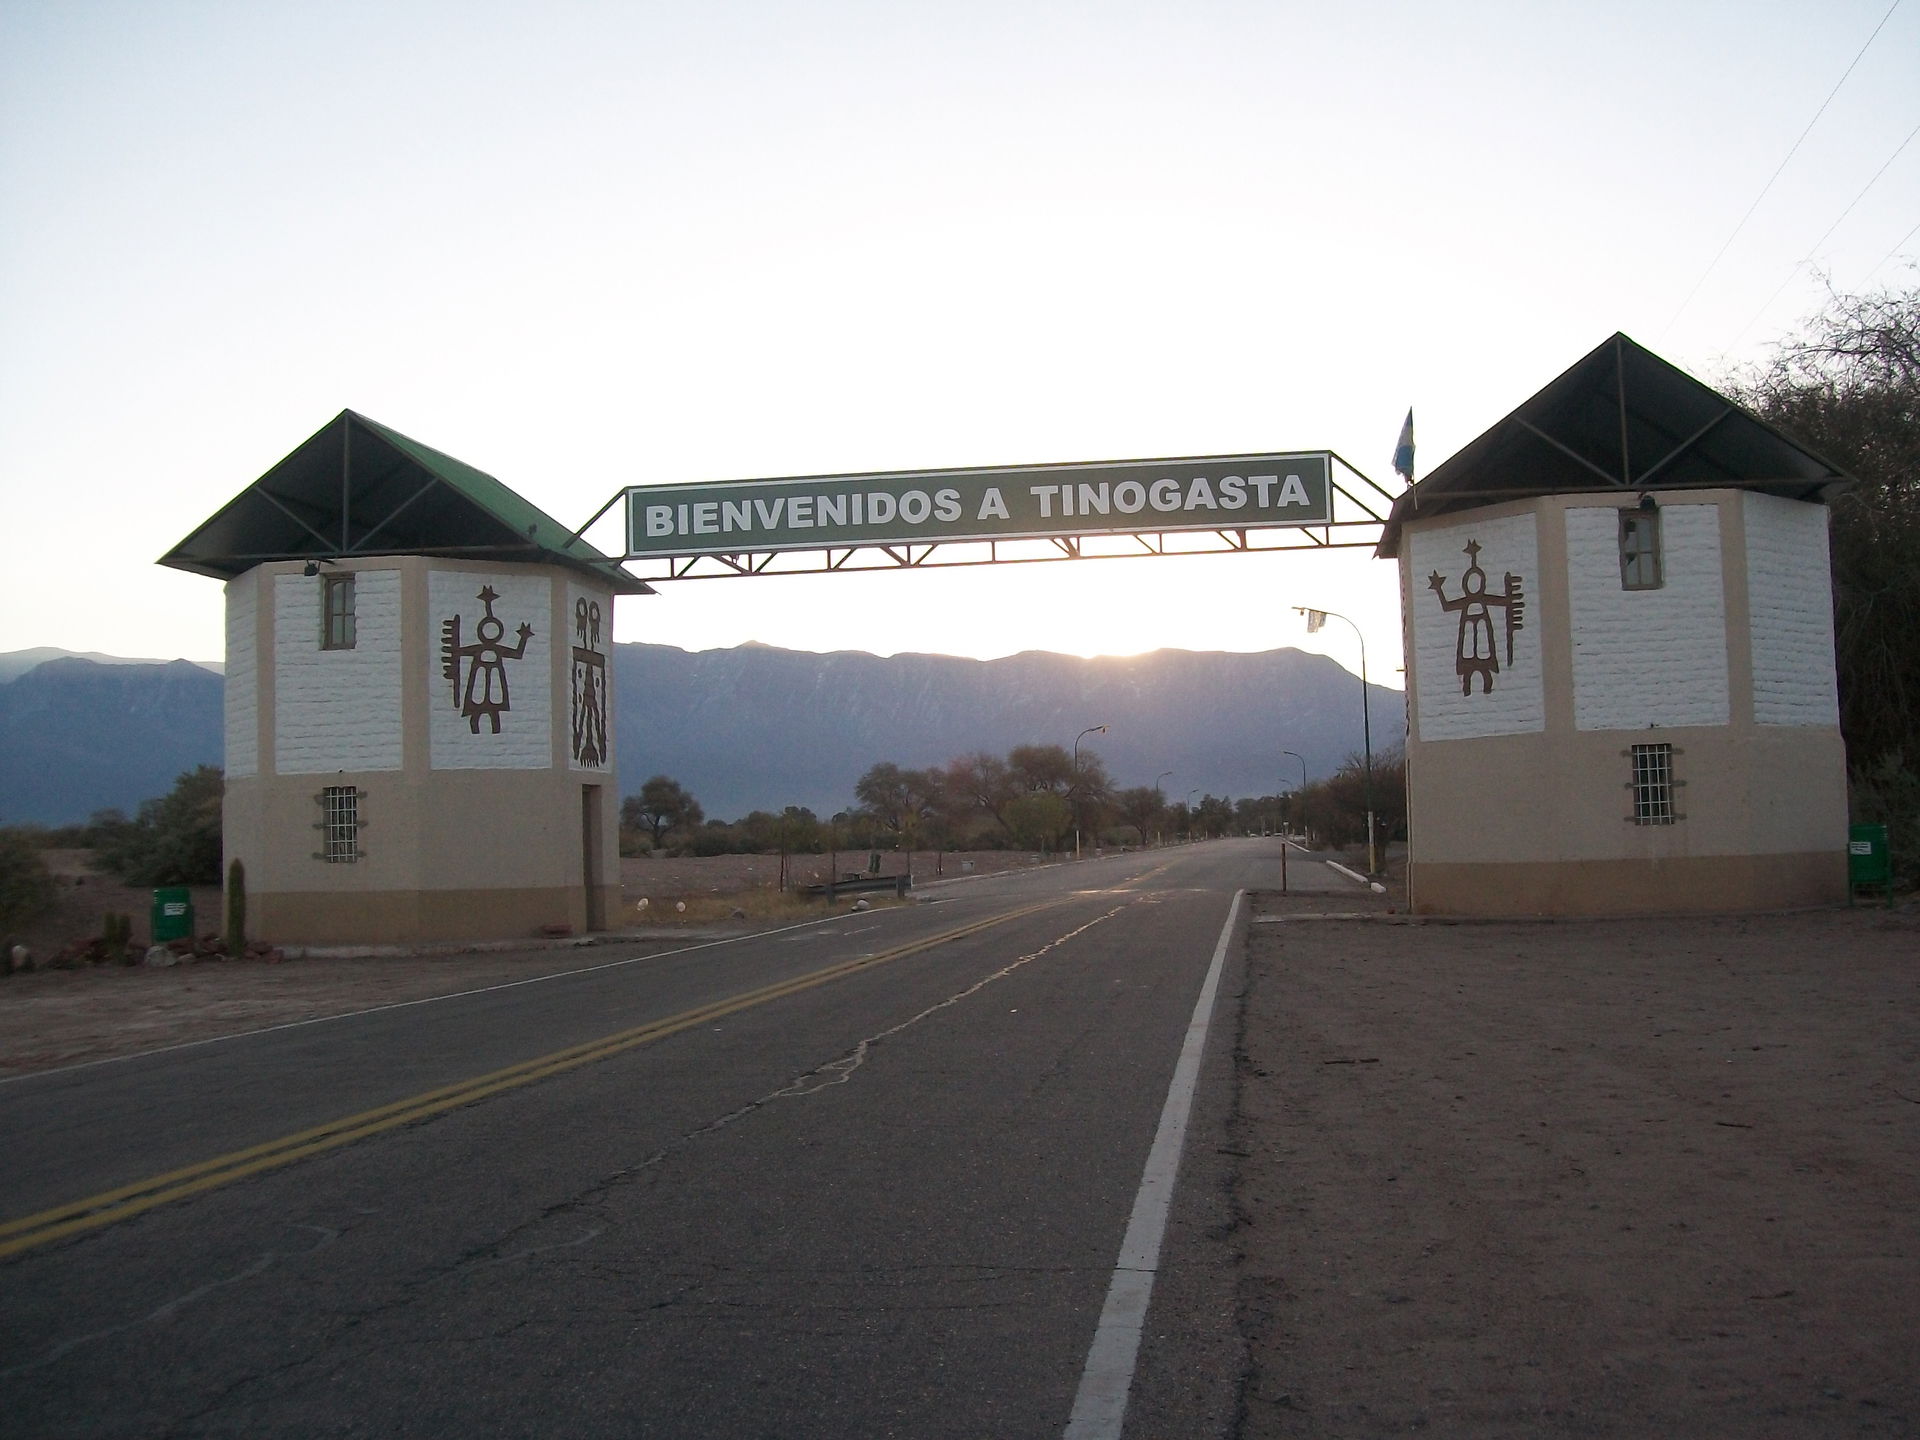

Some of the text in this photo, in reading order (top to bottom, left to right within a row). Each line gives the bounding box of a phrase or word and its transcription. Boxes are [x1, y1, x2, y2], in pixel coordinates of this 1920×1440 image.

[646, 474, 1310, 538] BIENVENIDOS A TINOGASTA
